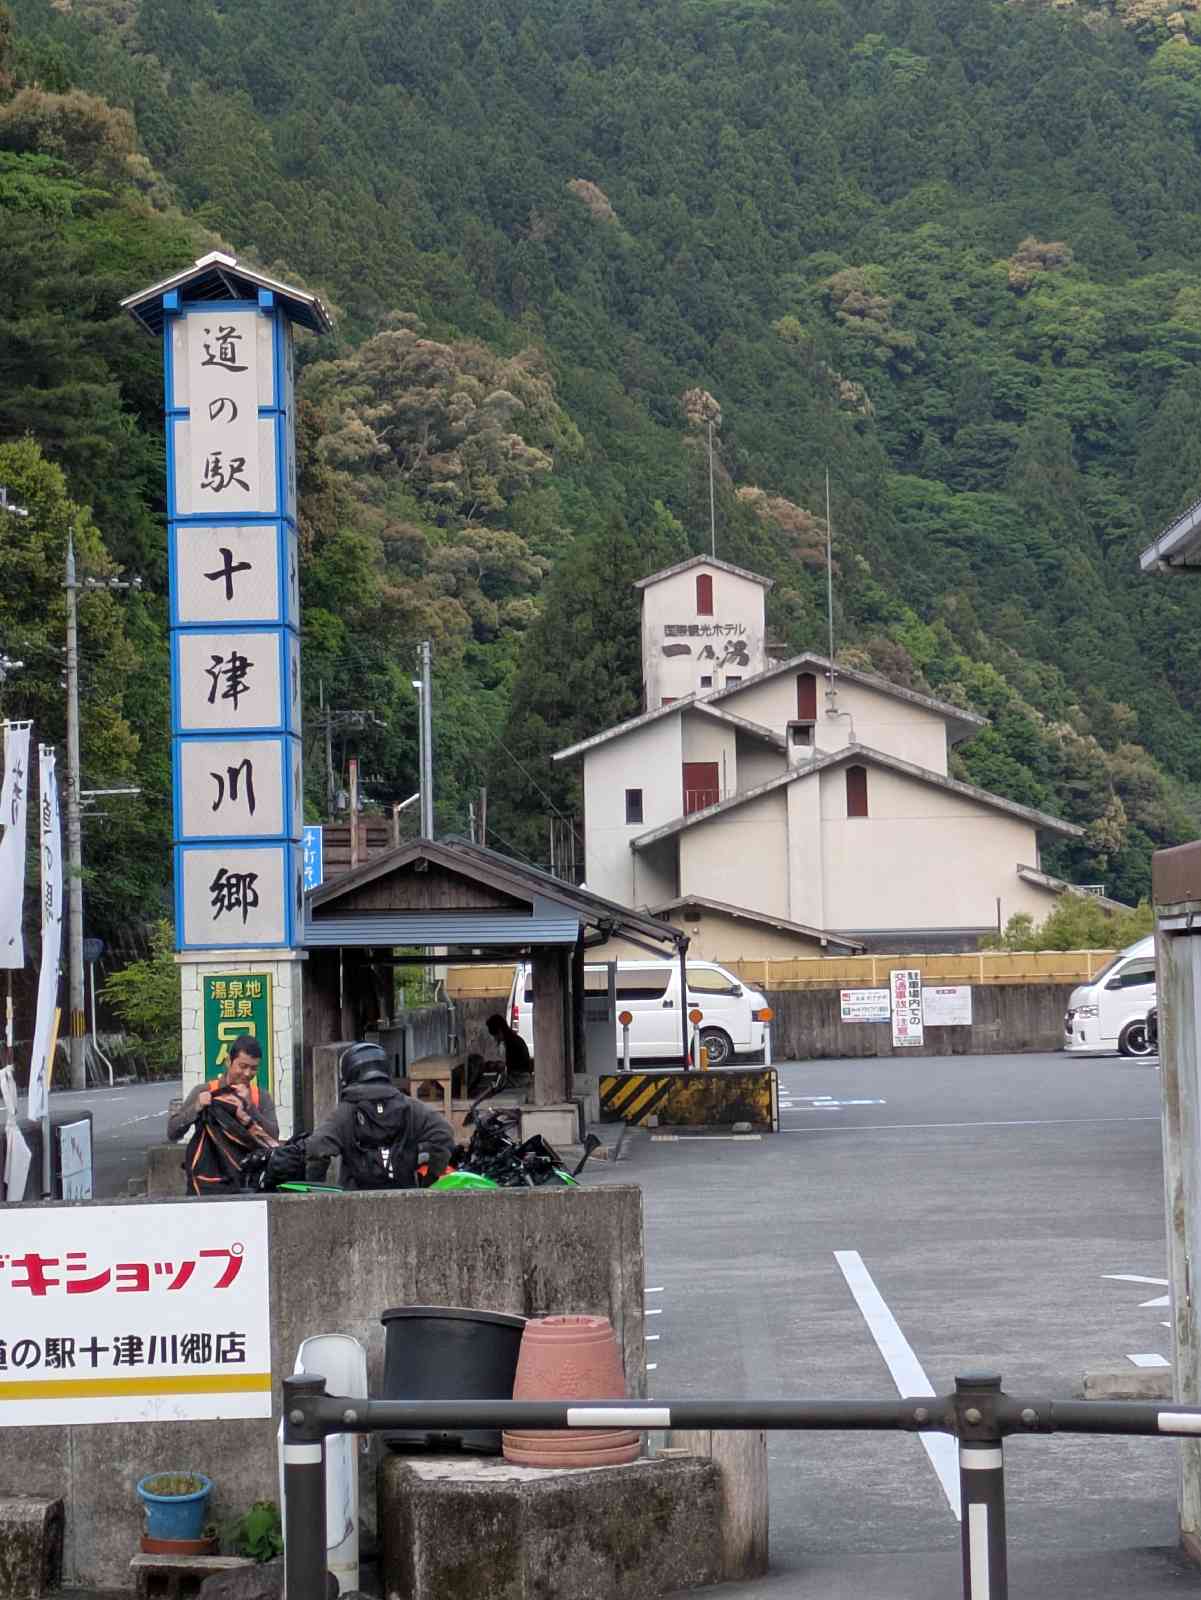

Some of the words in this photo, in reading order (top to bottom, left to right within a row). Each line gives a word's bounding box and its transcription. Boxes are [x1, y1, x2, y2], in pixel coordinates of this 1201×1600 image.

[220, 999, 253, 1018] 温泉
[0, 1242, 244, 1296] キショップ
